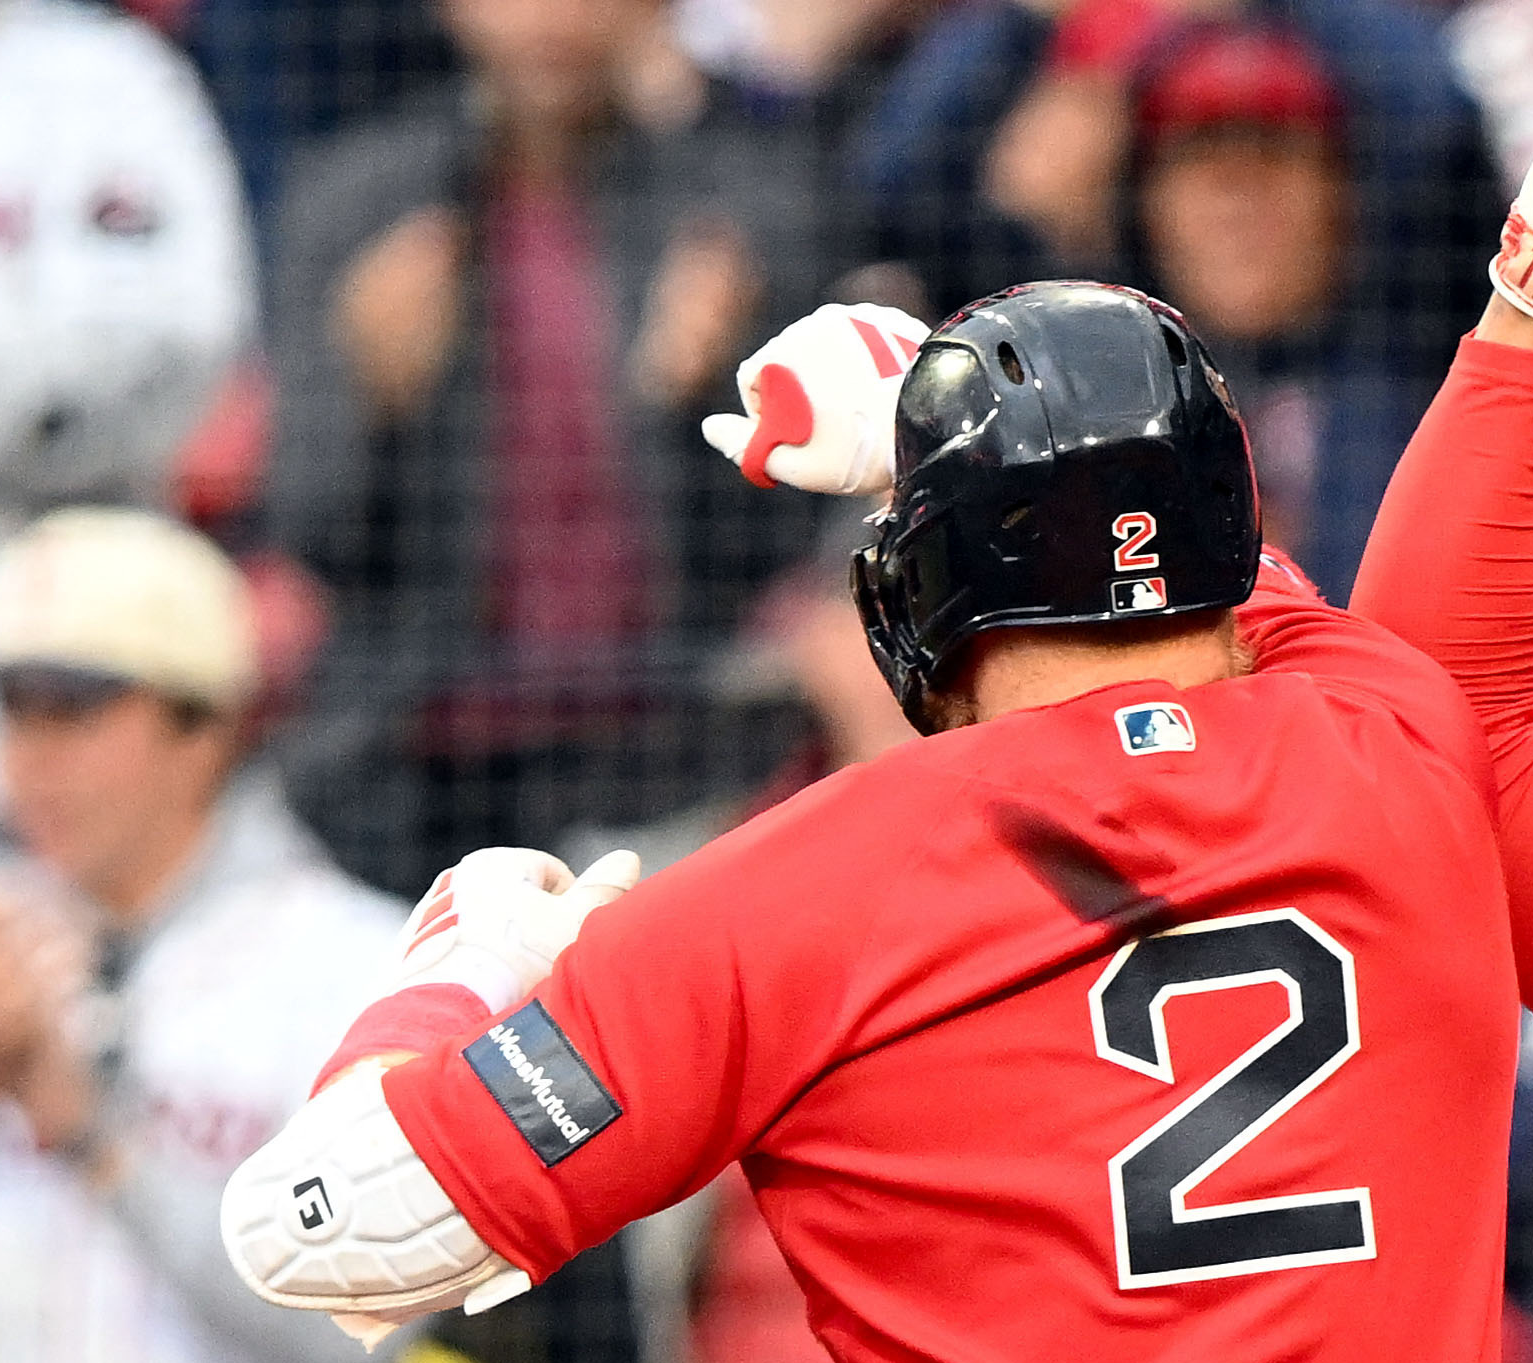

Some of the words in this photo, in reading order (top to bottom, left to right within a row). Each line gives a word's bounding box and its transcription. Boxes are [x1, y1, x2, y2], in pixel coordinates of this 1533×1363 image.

[1112, 511, 1159, 572] 2
[493, 1025, 591, 1144] MassMutual
[1088, 906, 1377, 1290] 2
